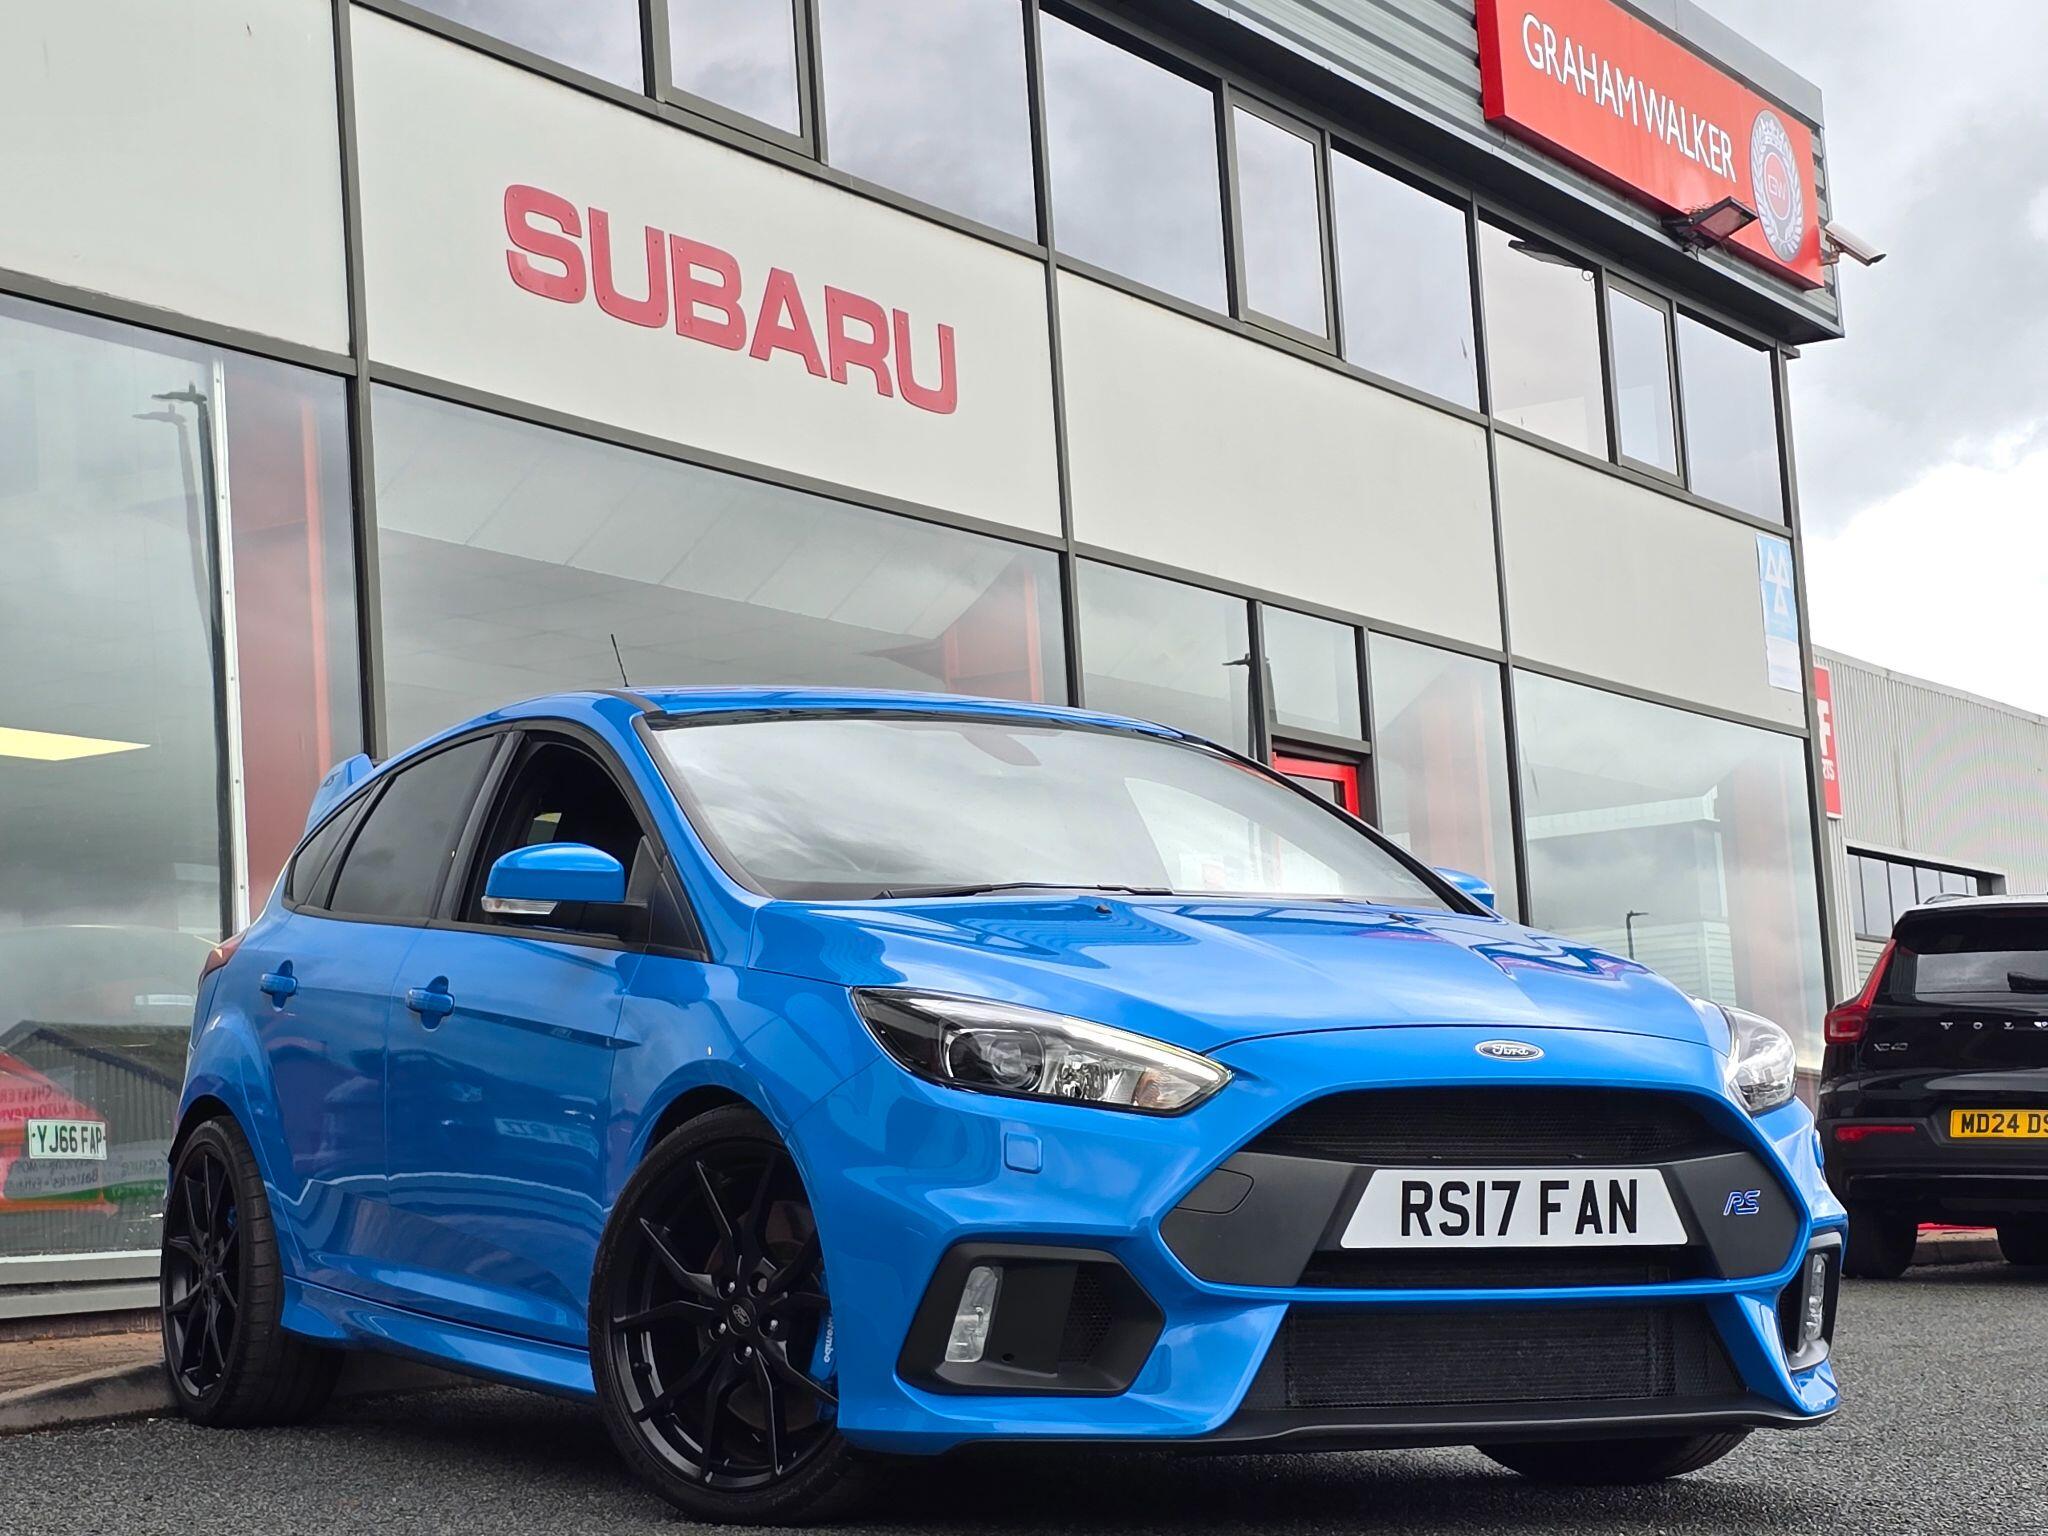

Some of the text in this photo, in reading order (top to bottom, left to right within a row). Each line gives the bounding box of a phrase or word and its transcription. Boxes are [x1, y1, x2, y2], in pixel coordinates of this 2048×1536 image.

[1522, 13, 1737, 183] GRAHAM WALKER
[504, 184, 958, 414] SUBARU
[37, 1125, 102, 1154] YJ66 FAP
[1961, 1113, 2020, 1133] MD24
[1400, 1179, 1638, 1237] RS17 FAN
[1723, 1190, 1760, 1216] RS
